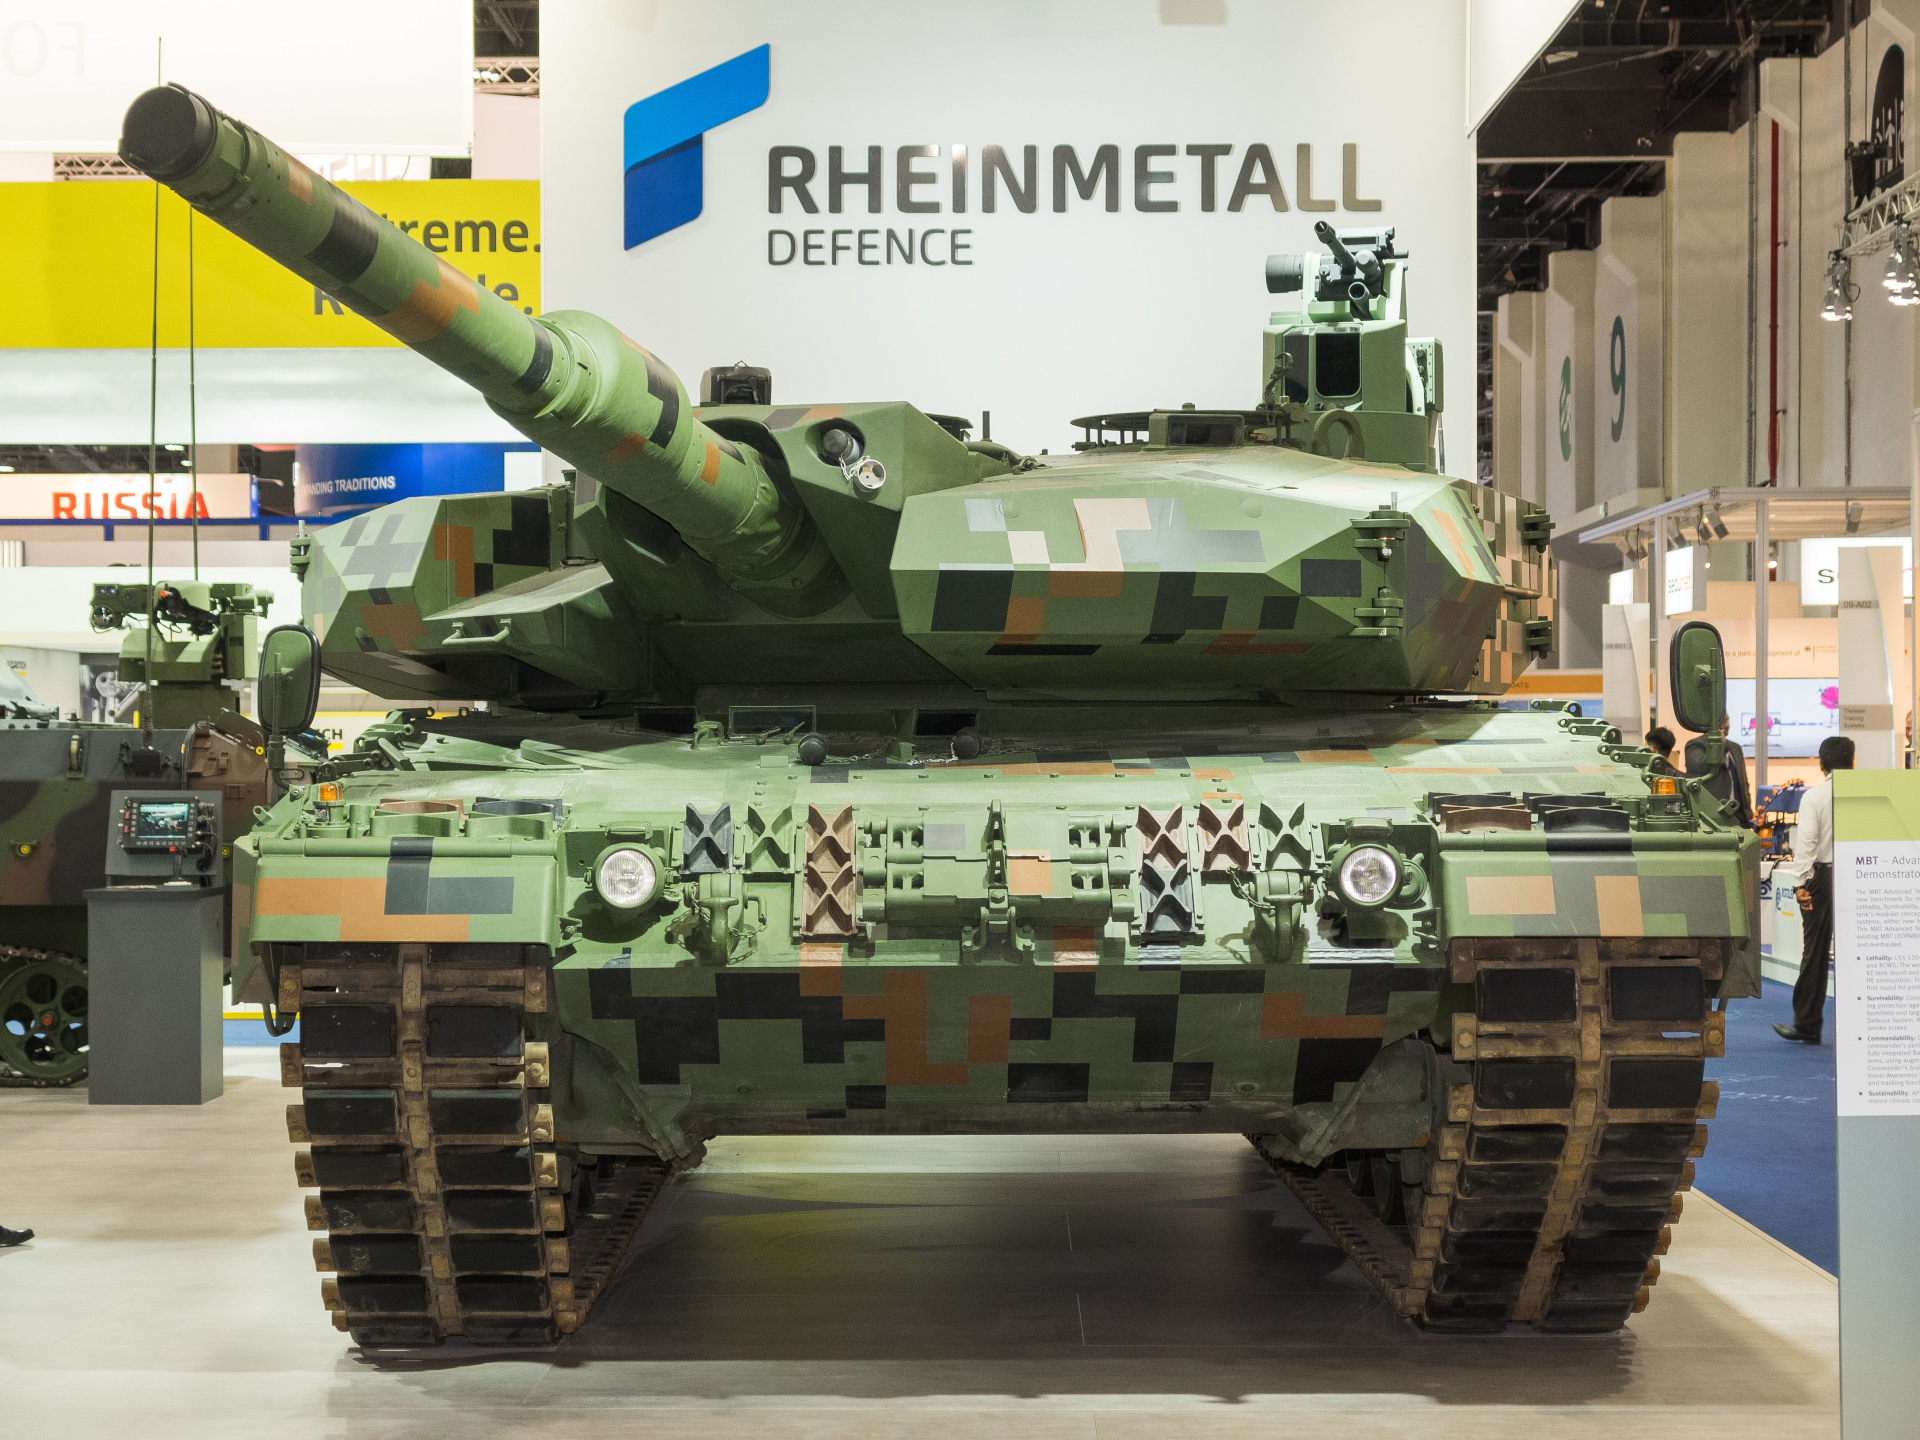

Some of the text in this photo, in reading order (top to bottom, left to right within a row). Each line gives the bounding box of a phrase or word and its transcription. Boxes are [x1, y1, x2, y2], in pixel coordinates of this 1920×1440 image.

[768, 143, 1384, 215] RHEINMETALL
[768, 229, 975, 266] DEFENCE
[1610, 315, 1626, 443] 9
[335, 475, 396, 492] TRADITIONS
[52, 491, 210, 519] RUSSIA
[1843, 601, 1872, 609] 09-A02
[1856, 856, 1878, 865] MBT
